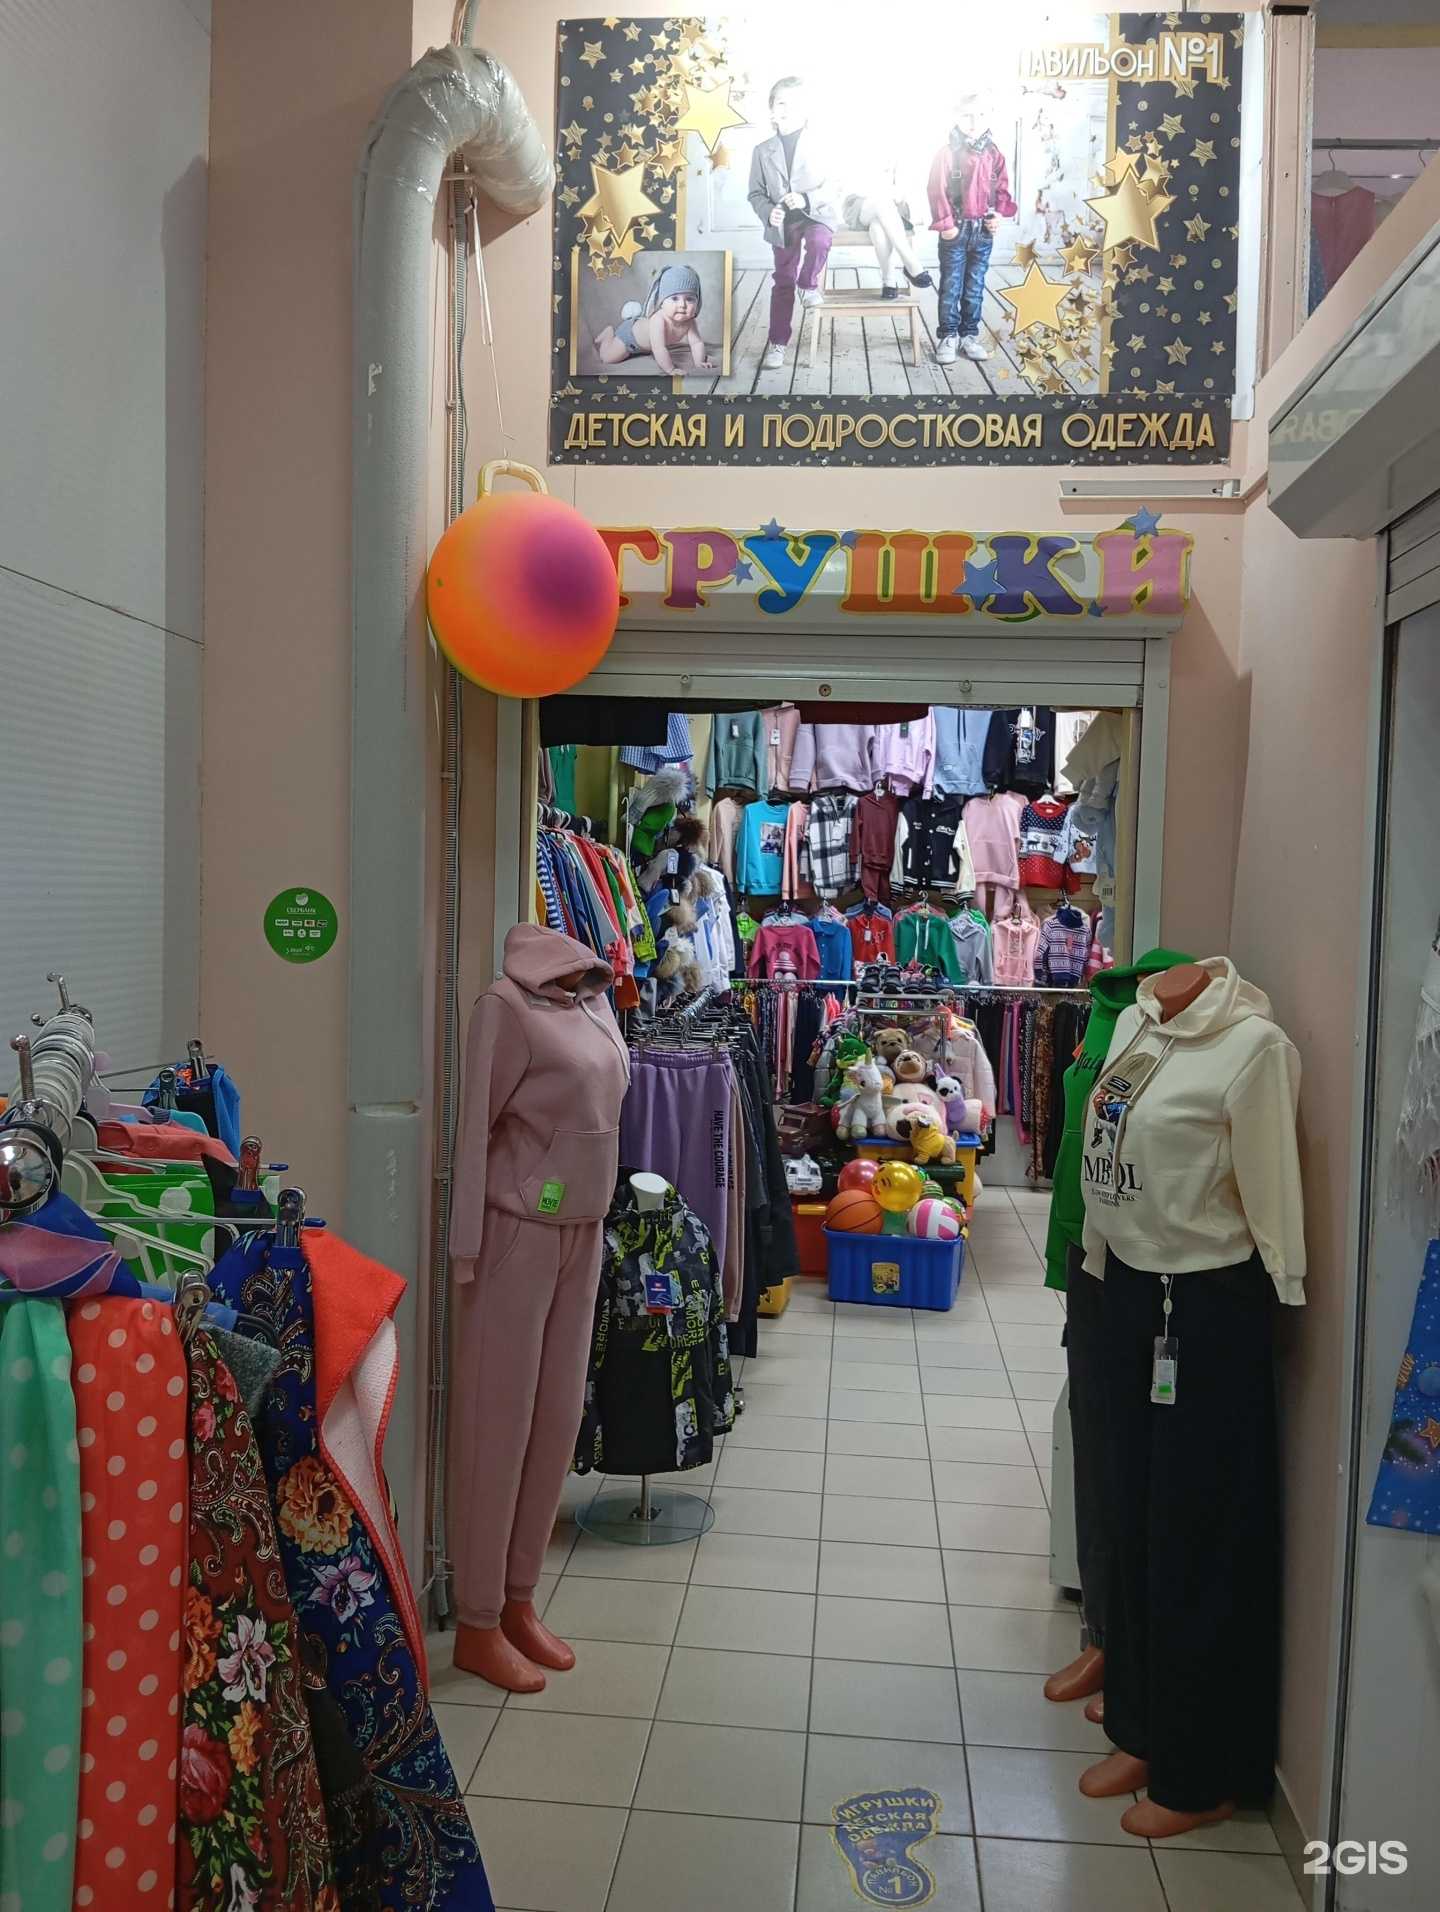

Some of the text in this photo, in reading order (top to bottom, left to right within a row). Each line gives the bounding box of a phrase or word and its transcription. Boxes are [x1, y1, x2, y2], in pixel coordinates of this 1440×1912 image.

[1164, 36, 1219, 78] №1
[564, 412, 1216, 451] ДЕТСКАЯ И ПОДРОСТКОВАЯ ОДЕЖДА
[597, 528, 1194, 622] ГРУШКИ
[712, 1110, 726, 1189] HAVE THE COURAGE
[839, 1797, 934, 1820] ИГРУШКИ
